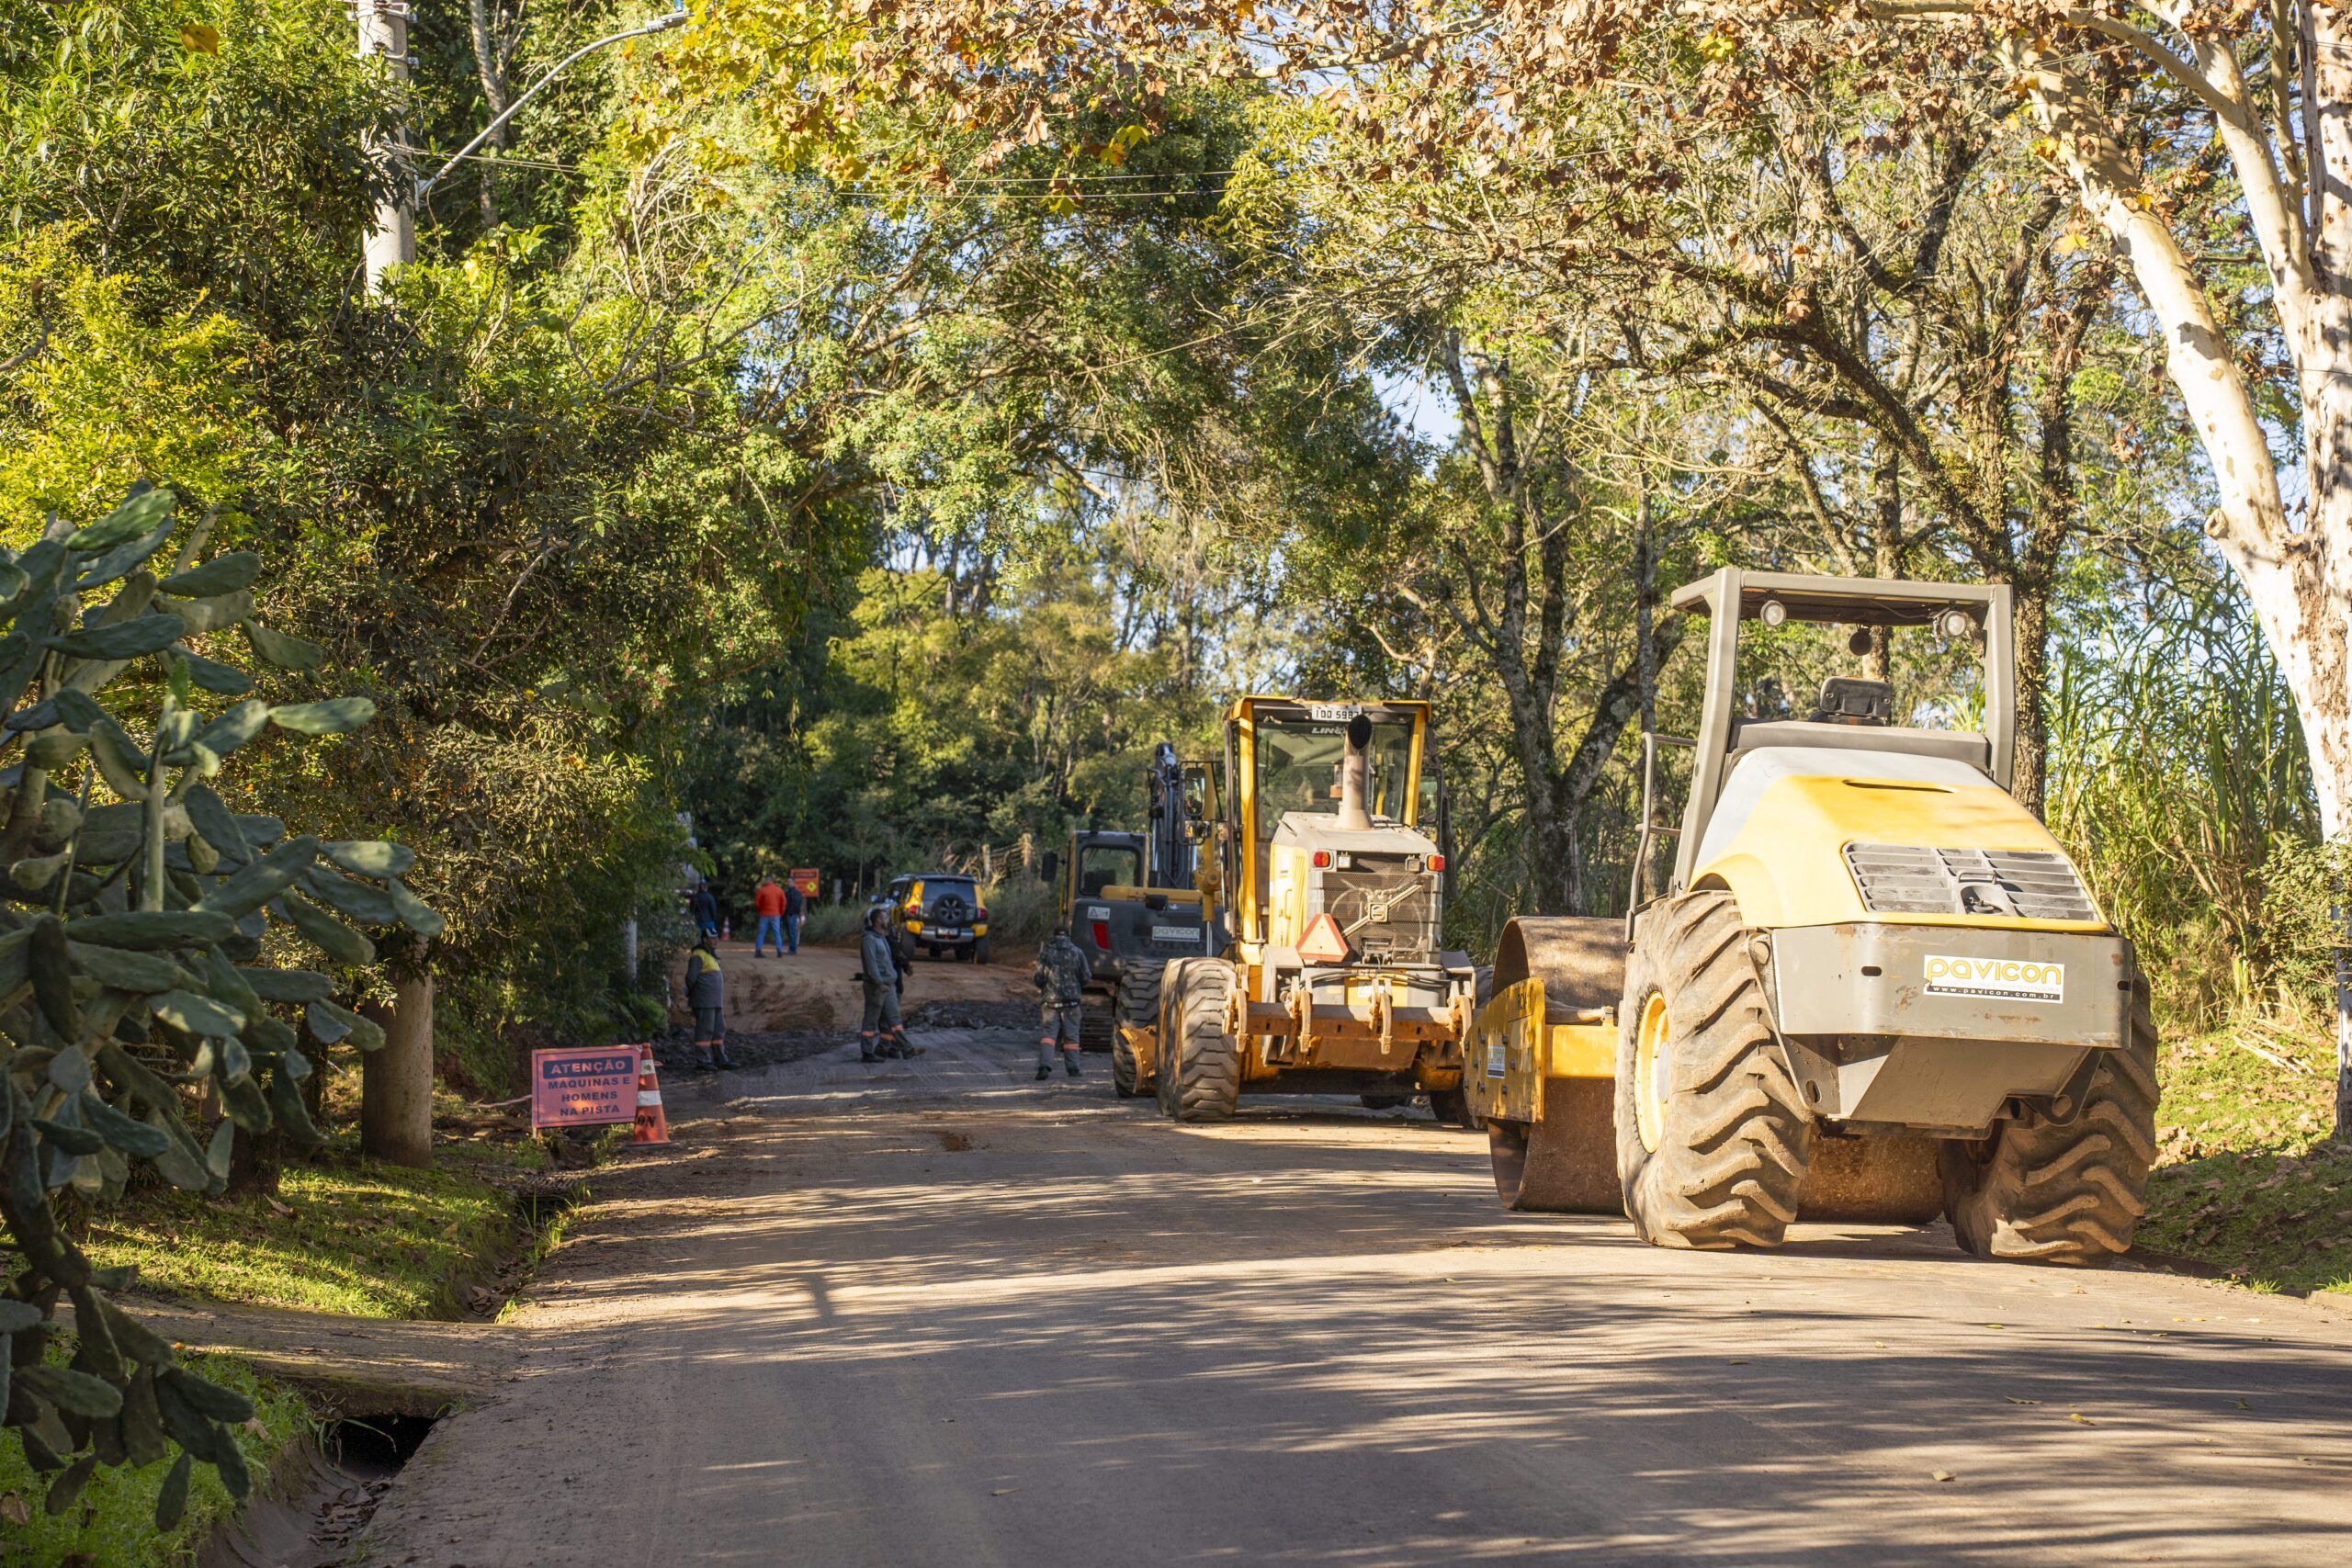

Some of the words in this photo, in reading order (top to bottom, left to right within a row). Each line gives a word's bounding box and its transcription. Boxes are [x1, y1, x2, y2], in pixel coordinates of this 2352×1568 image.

[1927, 958, 2061, 985] pavicon
[1933, 987, 2054, 998] www.pavicon.com.br
[551, 1059, 626, 1074] ATENÇÃO
[548, 1077, 618, 1089] MAQUINAS
[623, 1077, 630, 1085] E
[561, 1090, 617, 1102] HOMENS
[560, 1108, 578, 1116] NA
[582, 1104, 620, 1115] PISTA
